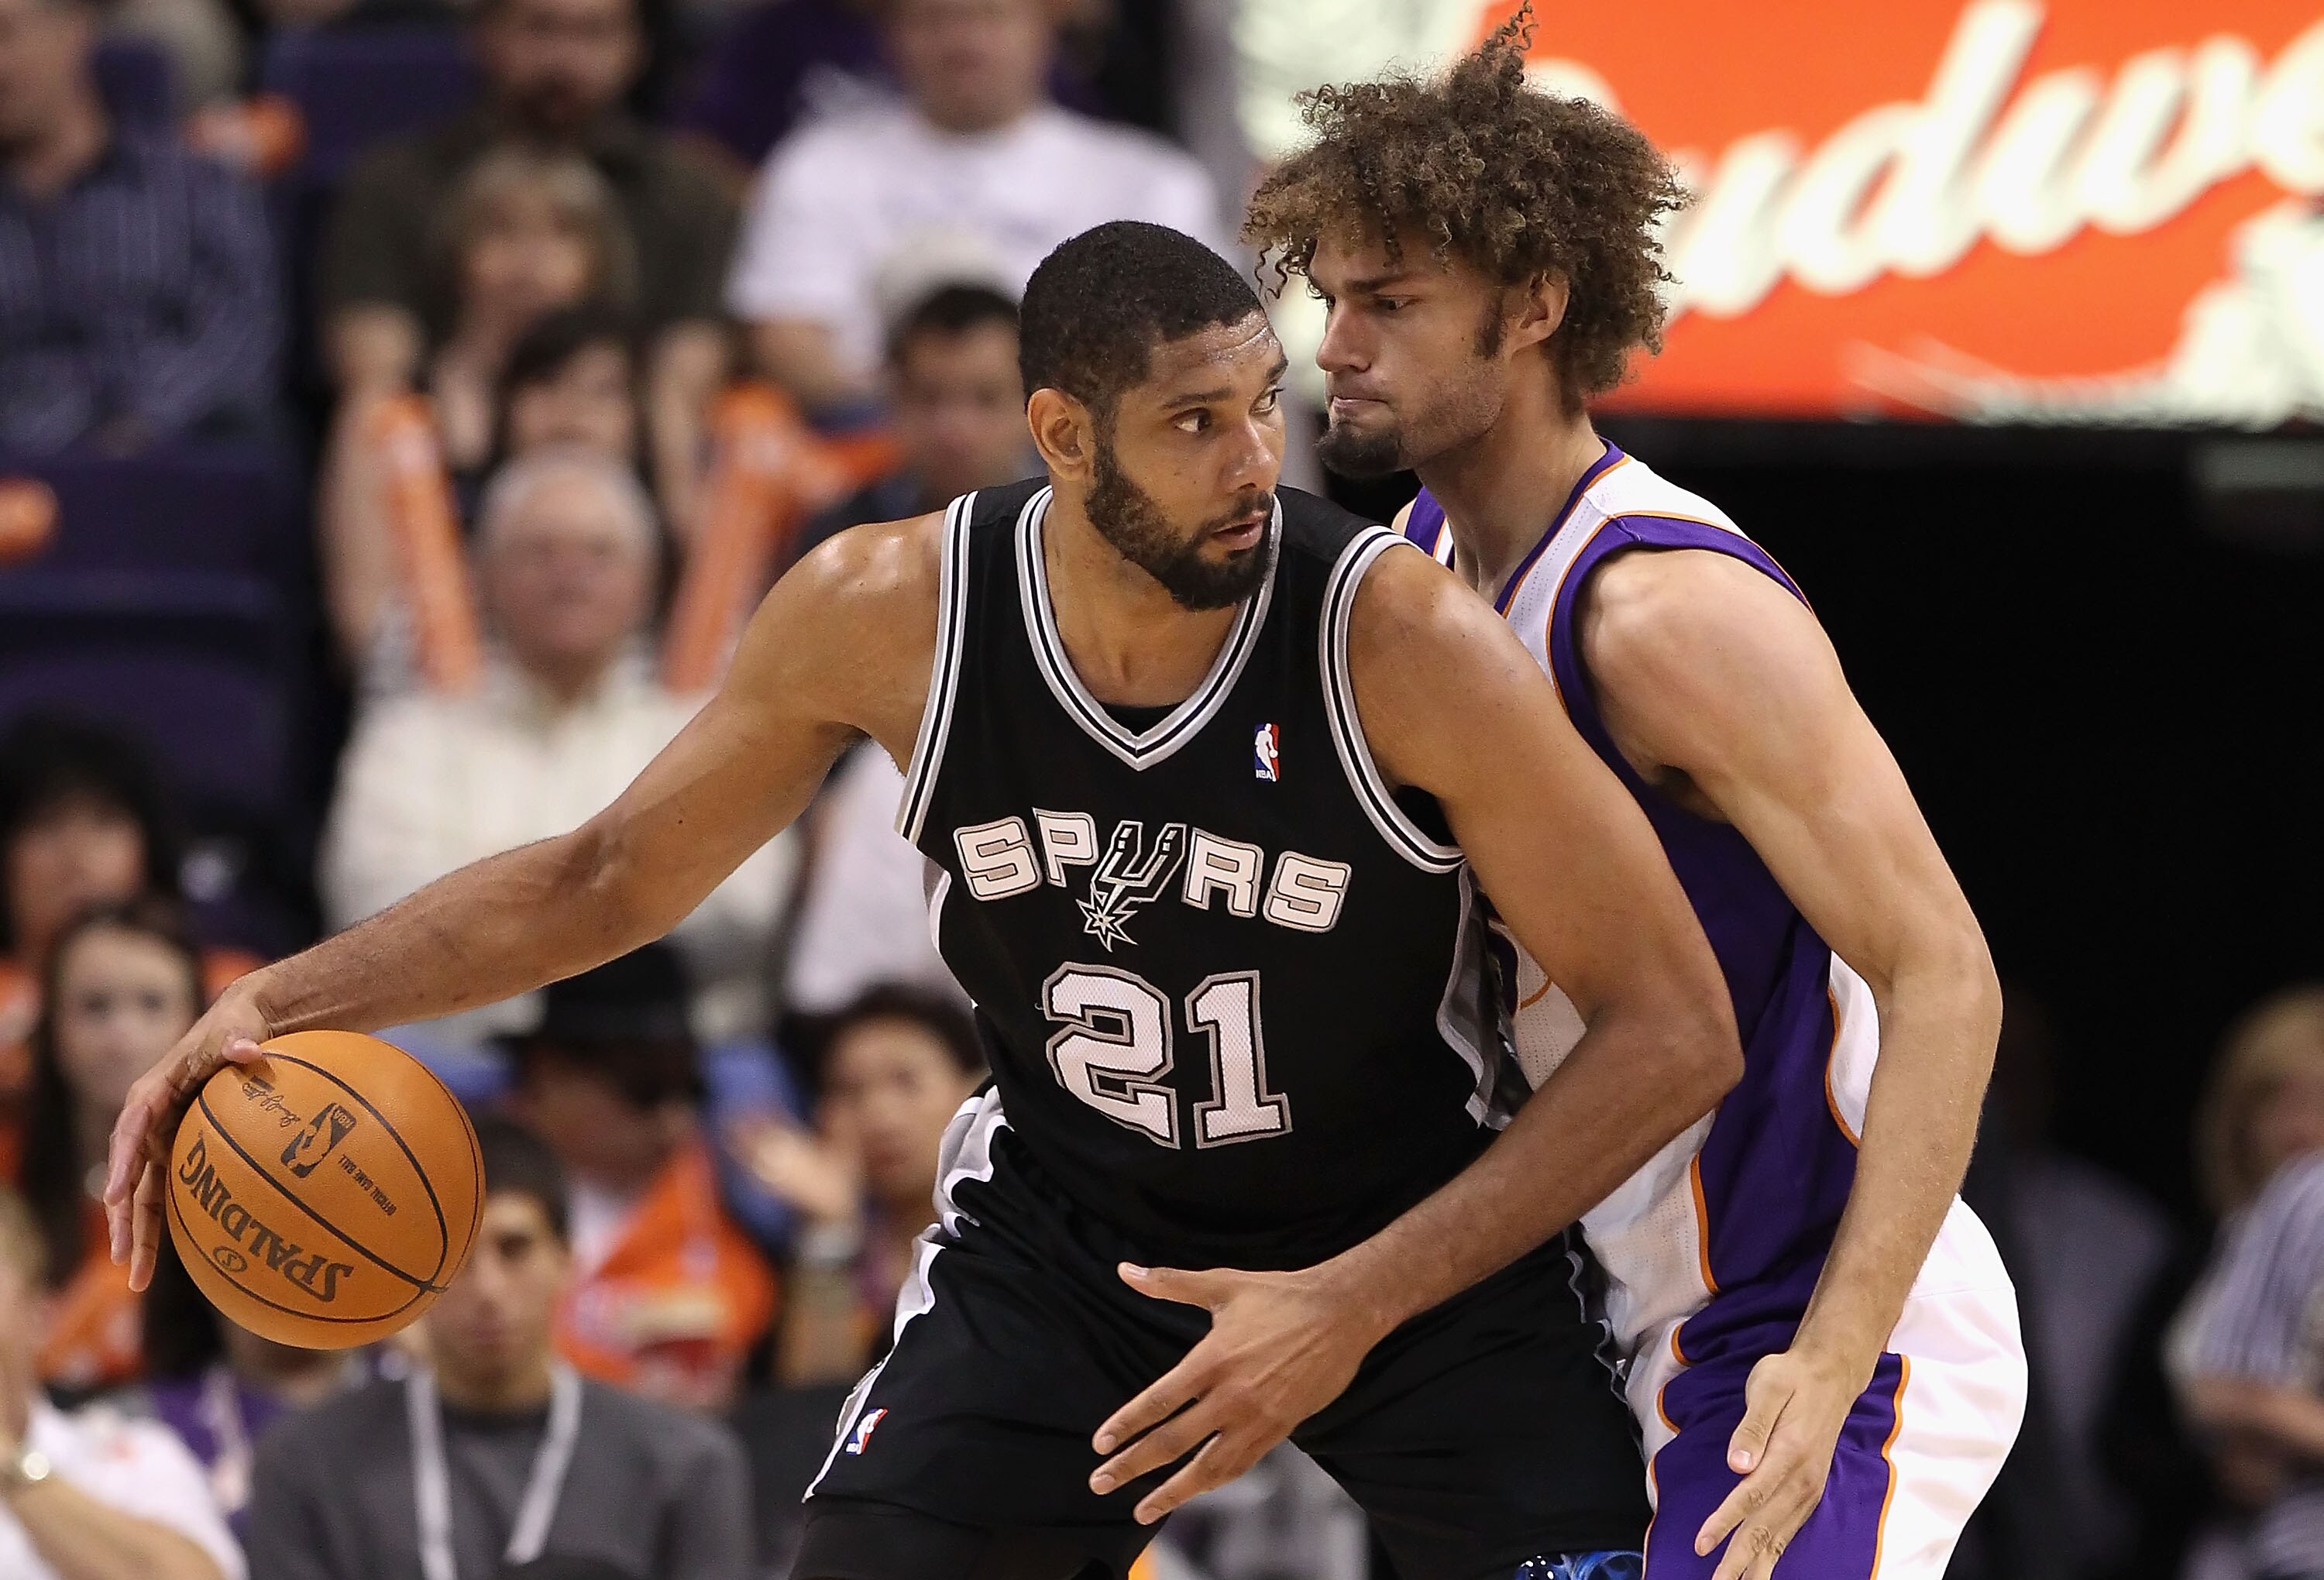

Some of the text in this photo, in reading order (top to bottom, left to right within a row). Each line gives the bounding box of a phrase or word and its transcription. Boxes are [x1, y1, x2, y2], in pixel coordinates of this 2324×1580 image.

[953, 807, 1353, 953] SPURS
[334, 1110, 353, 1128] NBA
[1042, 961, 1294, 1149] 21
[179, 1131, 354, 1301] SPALDING
[339, 1155, 356, 1174] BALL
